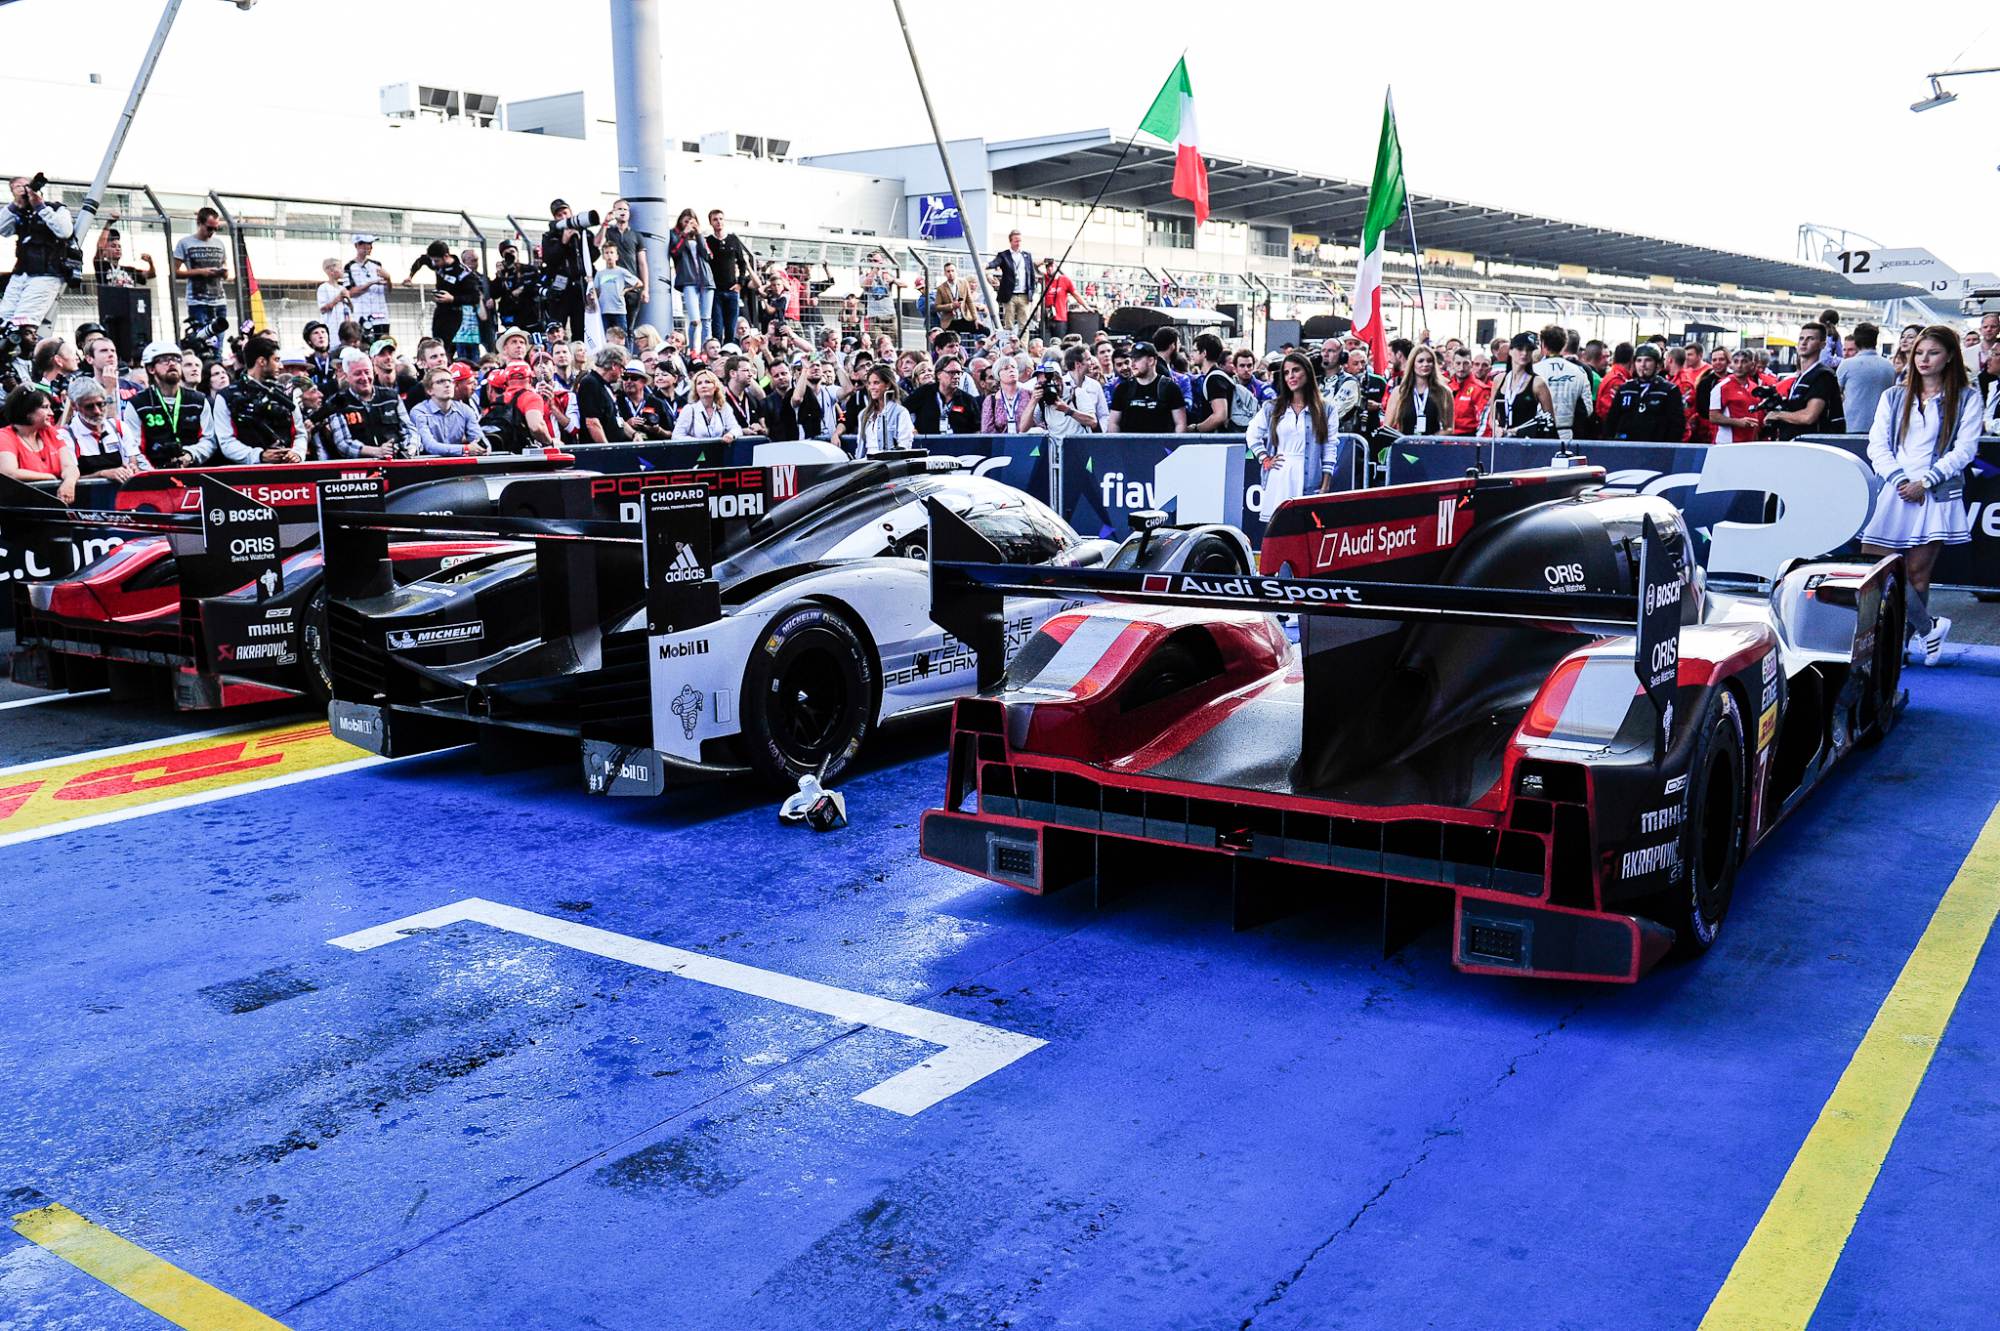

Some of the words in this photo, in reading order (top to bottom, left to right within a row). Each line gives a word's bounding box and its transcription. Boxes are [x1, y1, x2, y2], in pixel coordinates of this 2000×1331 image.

[1837, 250, 1871, 275] 12
[1551, 362, 1564, 371] TV
[324, 482, 378, 494] CHOPARD
[772, 465, 796, 497] HY
[258, 486, 310, 504] Sport
[651, 489, 704, 502] CHOPARD
[228, 508, 273, 523] BOSCH
[1436, 499, 1457, 547] HY
[230, 536, 275, 556] ORIS
[1338, 530, 1374, 557] Audi
[1378, 524, 1417, 556] Sport
[231, 555, 249, 563] Swiss
[249, 553, 275, 561] Watches
[665, 567, 706, 583] adidas
[1544, 563, 1585, 585] ORIS
[1181, 575, 1254, 597] Audi
[1261, 580, 1362, 602] Sport
[1656, 580, 1681, 608] BOSCH
[248, 622, 295, 638] MAHLE
[781, 611, 821, 635] MICHELIN
[417, 625, 481, 641] MICHELIN
[659, 643, 696, 660] Mobil
[1651, 636, 1677, 673] ORIS
[339, 717, 364, 733] Mobil
